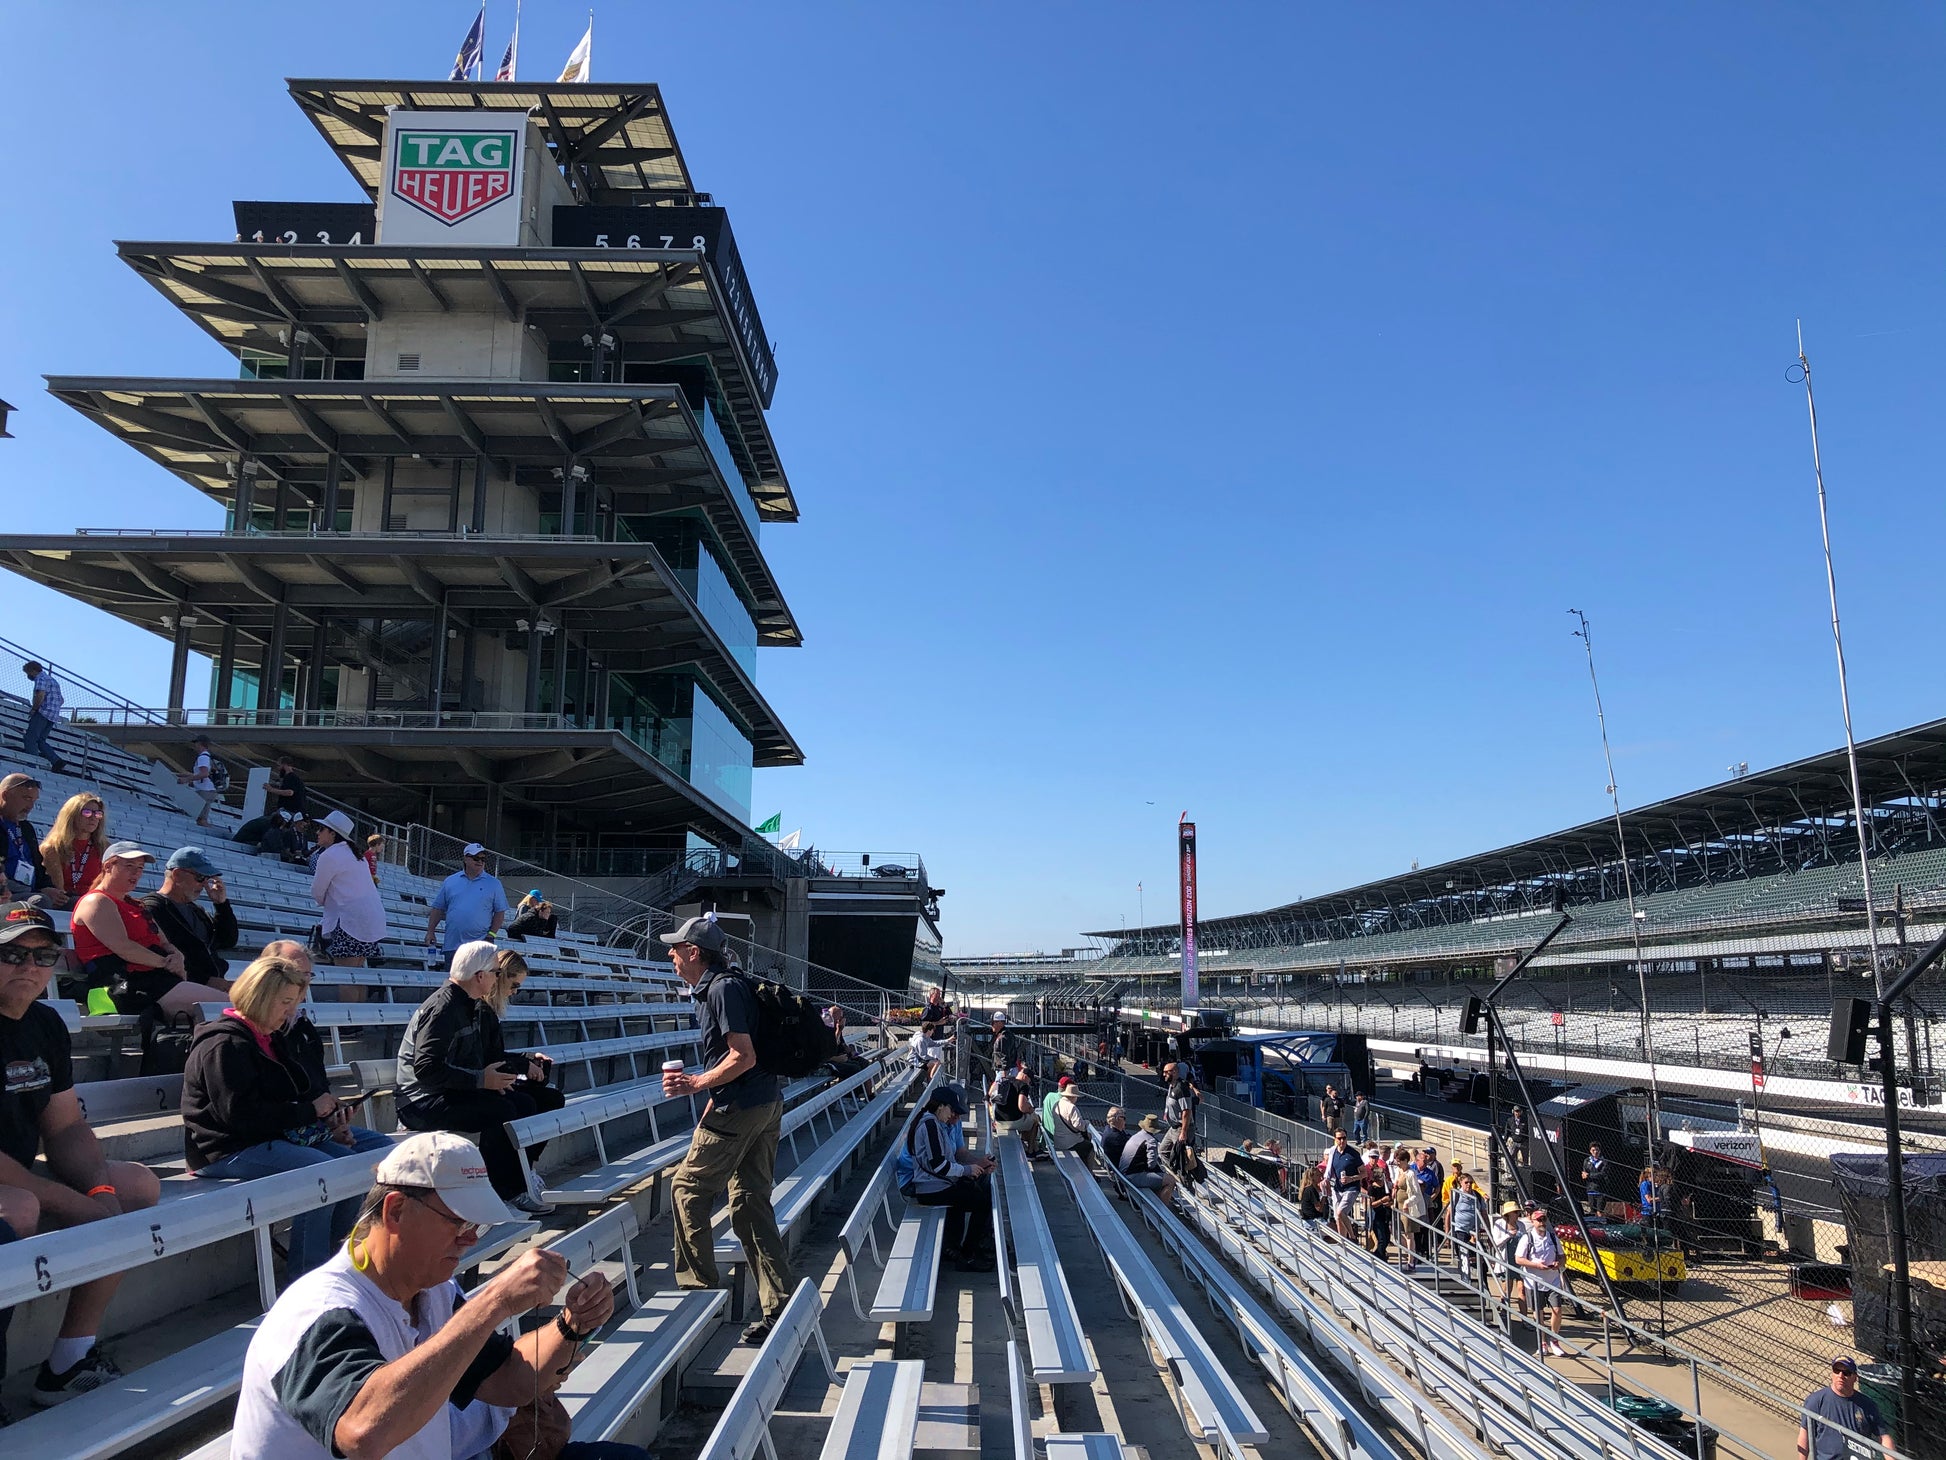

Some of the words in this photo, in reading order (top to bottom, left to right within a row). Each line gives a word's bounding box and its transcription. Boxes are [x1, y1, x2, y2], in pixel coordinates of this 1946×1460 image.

[408, 138, 503, 166] TAG
[401, 173, 505, 217] HEUER
[283, 230, 298, 244] 2
[317, 230, 330, 244] 3
[348, 231, 362, 245] 4
[595, 234, 609, 248] 5
[627, 235, 641, 248] 6
[660, 235, 674, 249] 7
[692, 235, 706, 254] 8
[725, 265, 731, 284] 1
[729, 278, 736, 298] 2
[310, 1009, 317, 1024] 3
[156, 1088, 168, 1110] 2
[556, 1117, 563, 1134] 2
[580, 1110, 588, 1126] 3
[1713, 1142, 1753, 1151] verizon
[34, 1255, 52, 1293] 6
[150, 1223, 165, 1257] 5
[245, 1197, 256, 1226] 4
[317, 1177, 329, 1203] 3
[588, 1240, 596, 1264] 2
[793, 1325, 804, 1349] 2
[1846, 1439, 1872, 1459] SECTION
